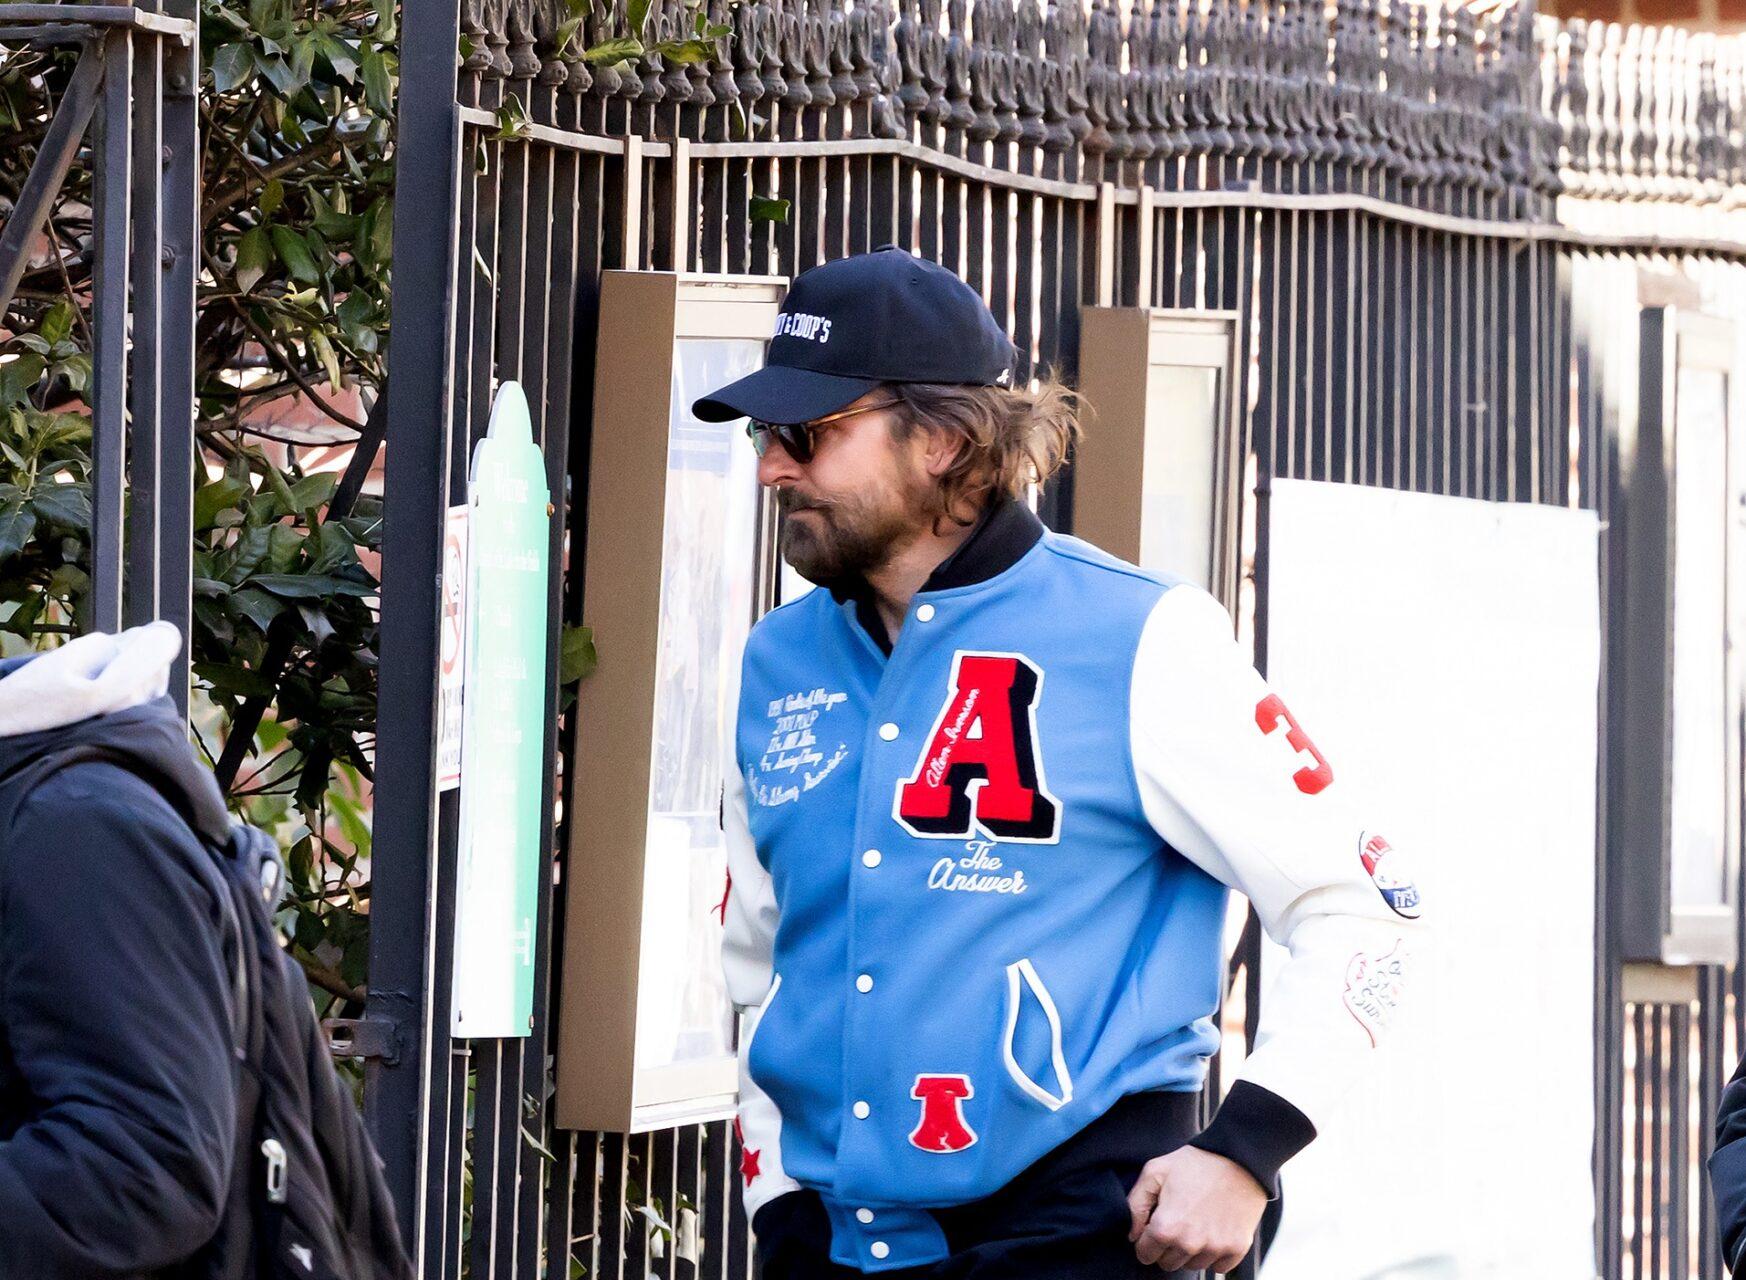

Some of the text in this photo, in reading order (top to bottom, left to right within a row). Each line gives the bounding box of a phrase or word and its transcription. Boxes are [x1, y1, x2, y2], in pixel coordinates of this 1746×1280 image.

[790, 313, 832, 343] COOP'S
[893, 651, 1062, 844] A
[1255, 693, 1335, 795] 3
[959, 840, 1003, 872] The
[928, 858, 1029, 895] Answer
